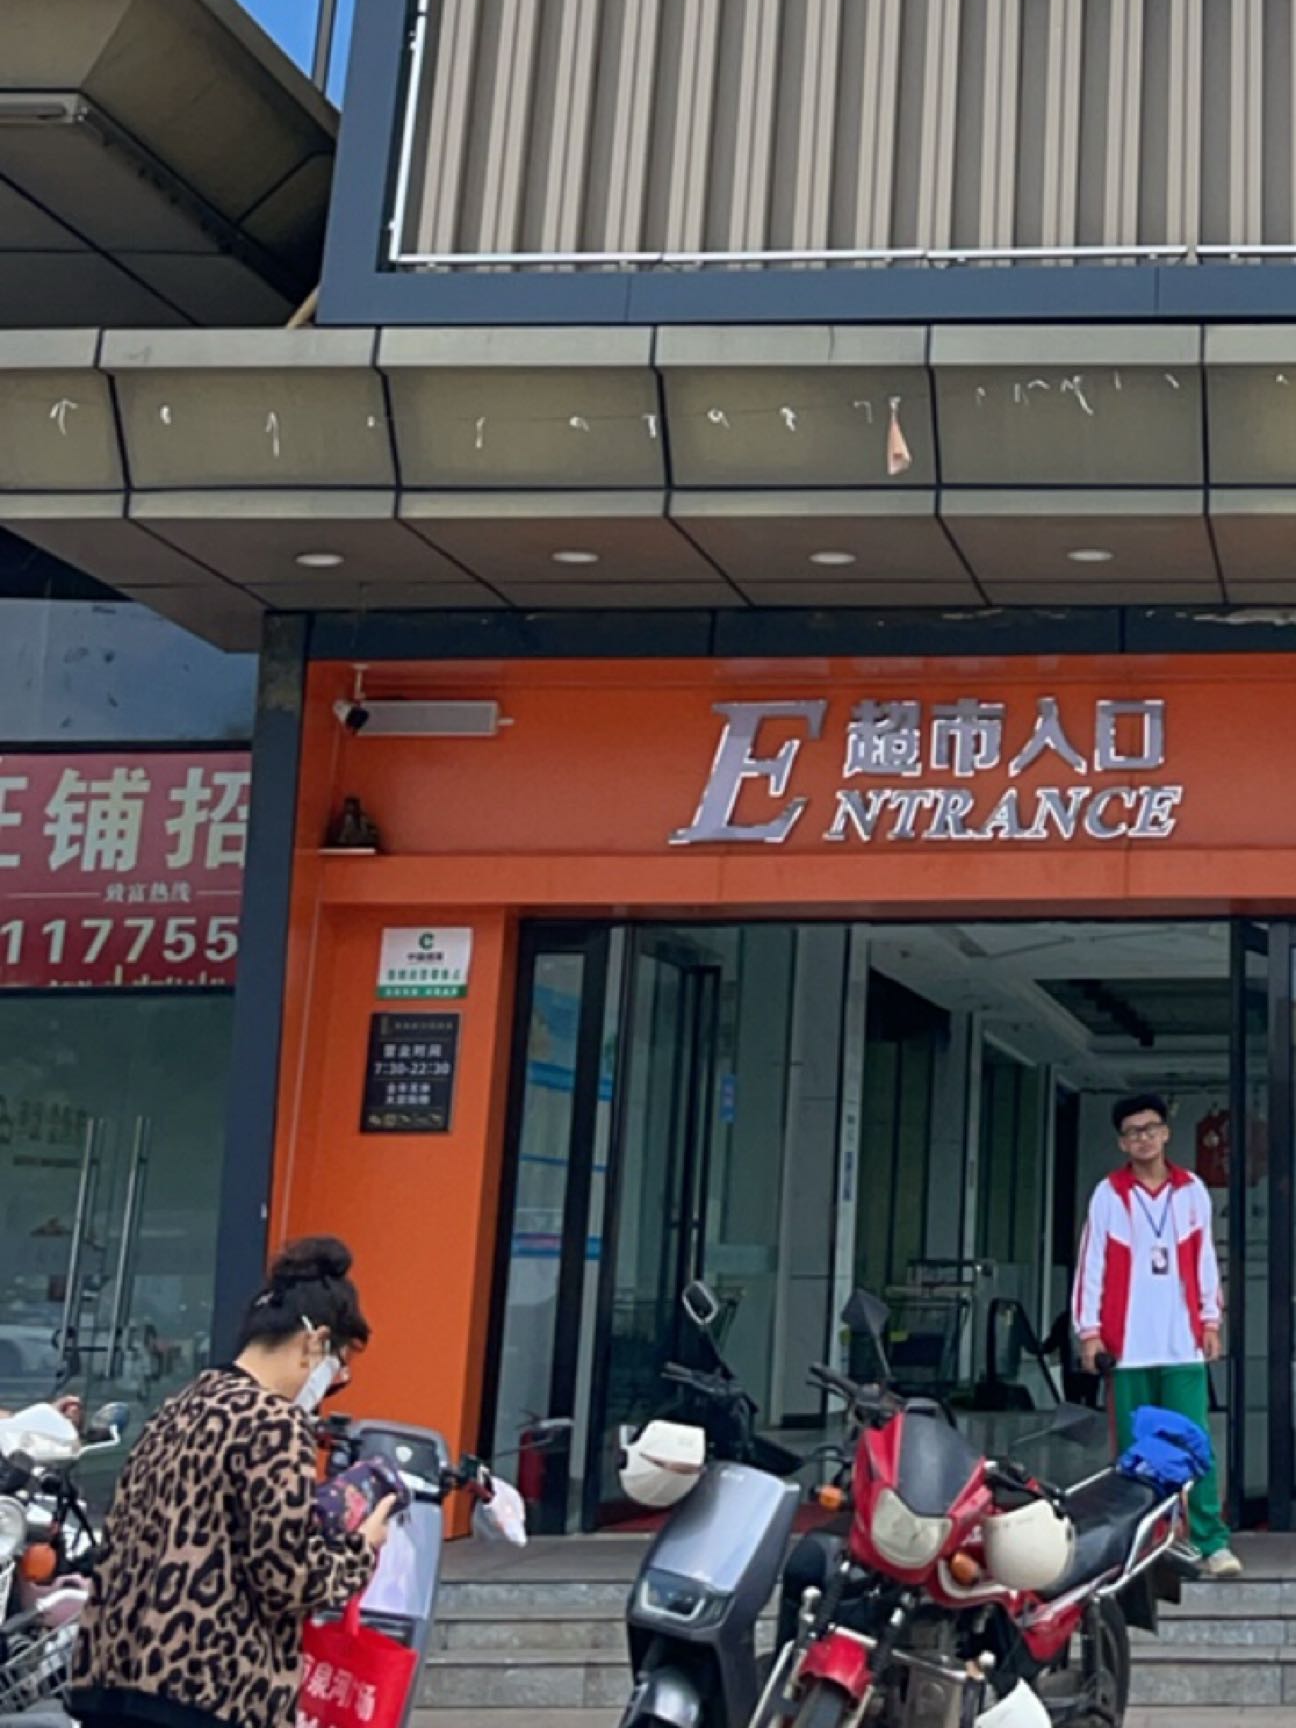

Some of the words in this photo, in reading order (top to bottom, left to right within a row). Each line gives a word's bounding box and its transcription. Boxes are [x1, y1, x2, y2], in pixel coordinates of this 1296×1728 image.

[842, 696, 1166, 778] 超市入口
[0, 916, 239, 965] 117755
